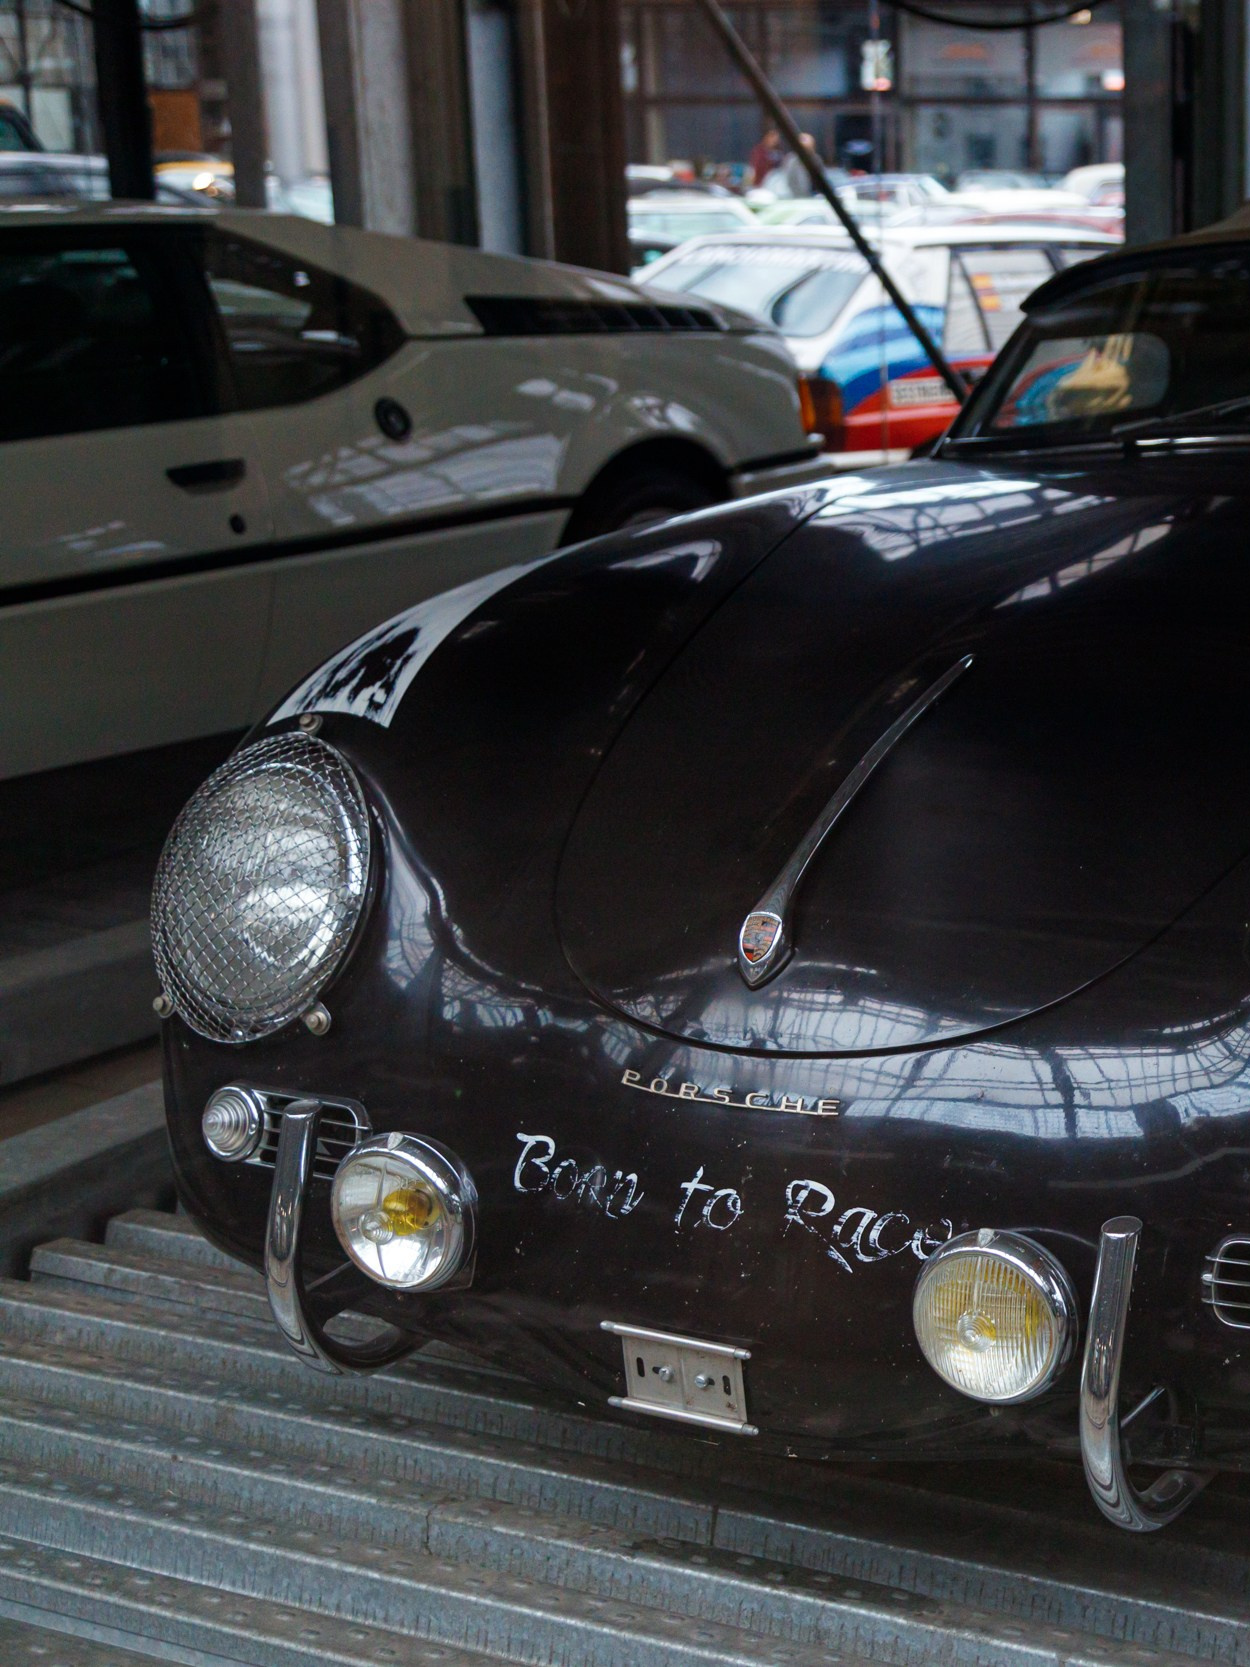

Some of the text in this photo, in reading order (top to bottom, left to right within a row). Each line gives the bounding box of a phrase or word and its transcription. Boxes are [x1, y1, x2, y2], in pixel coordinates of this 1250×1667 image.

[621, 1069, 840, 1115] PORSCHE
[674, 1166, 744, 1232] to
[783, 1179, 953, 1274] Race
